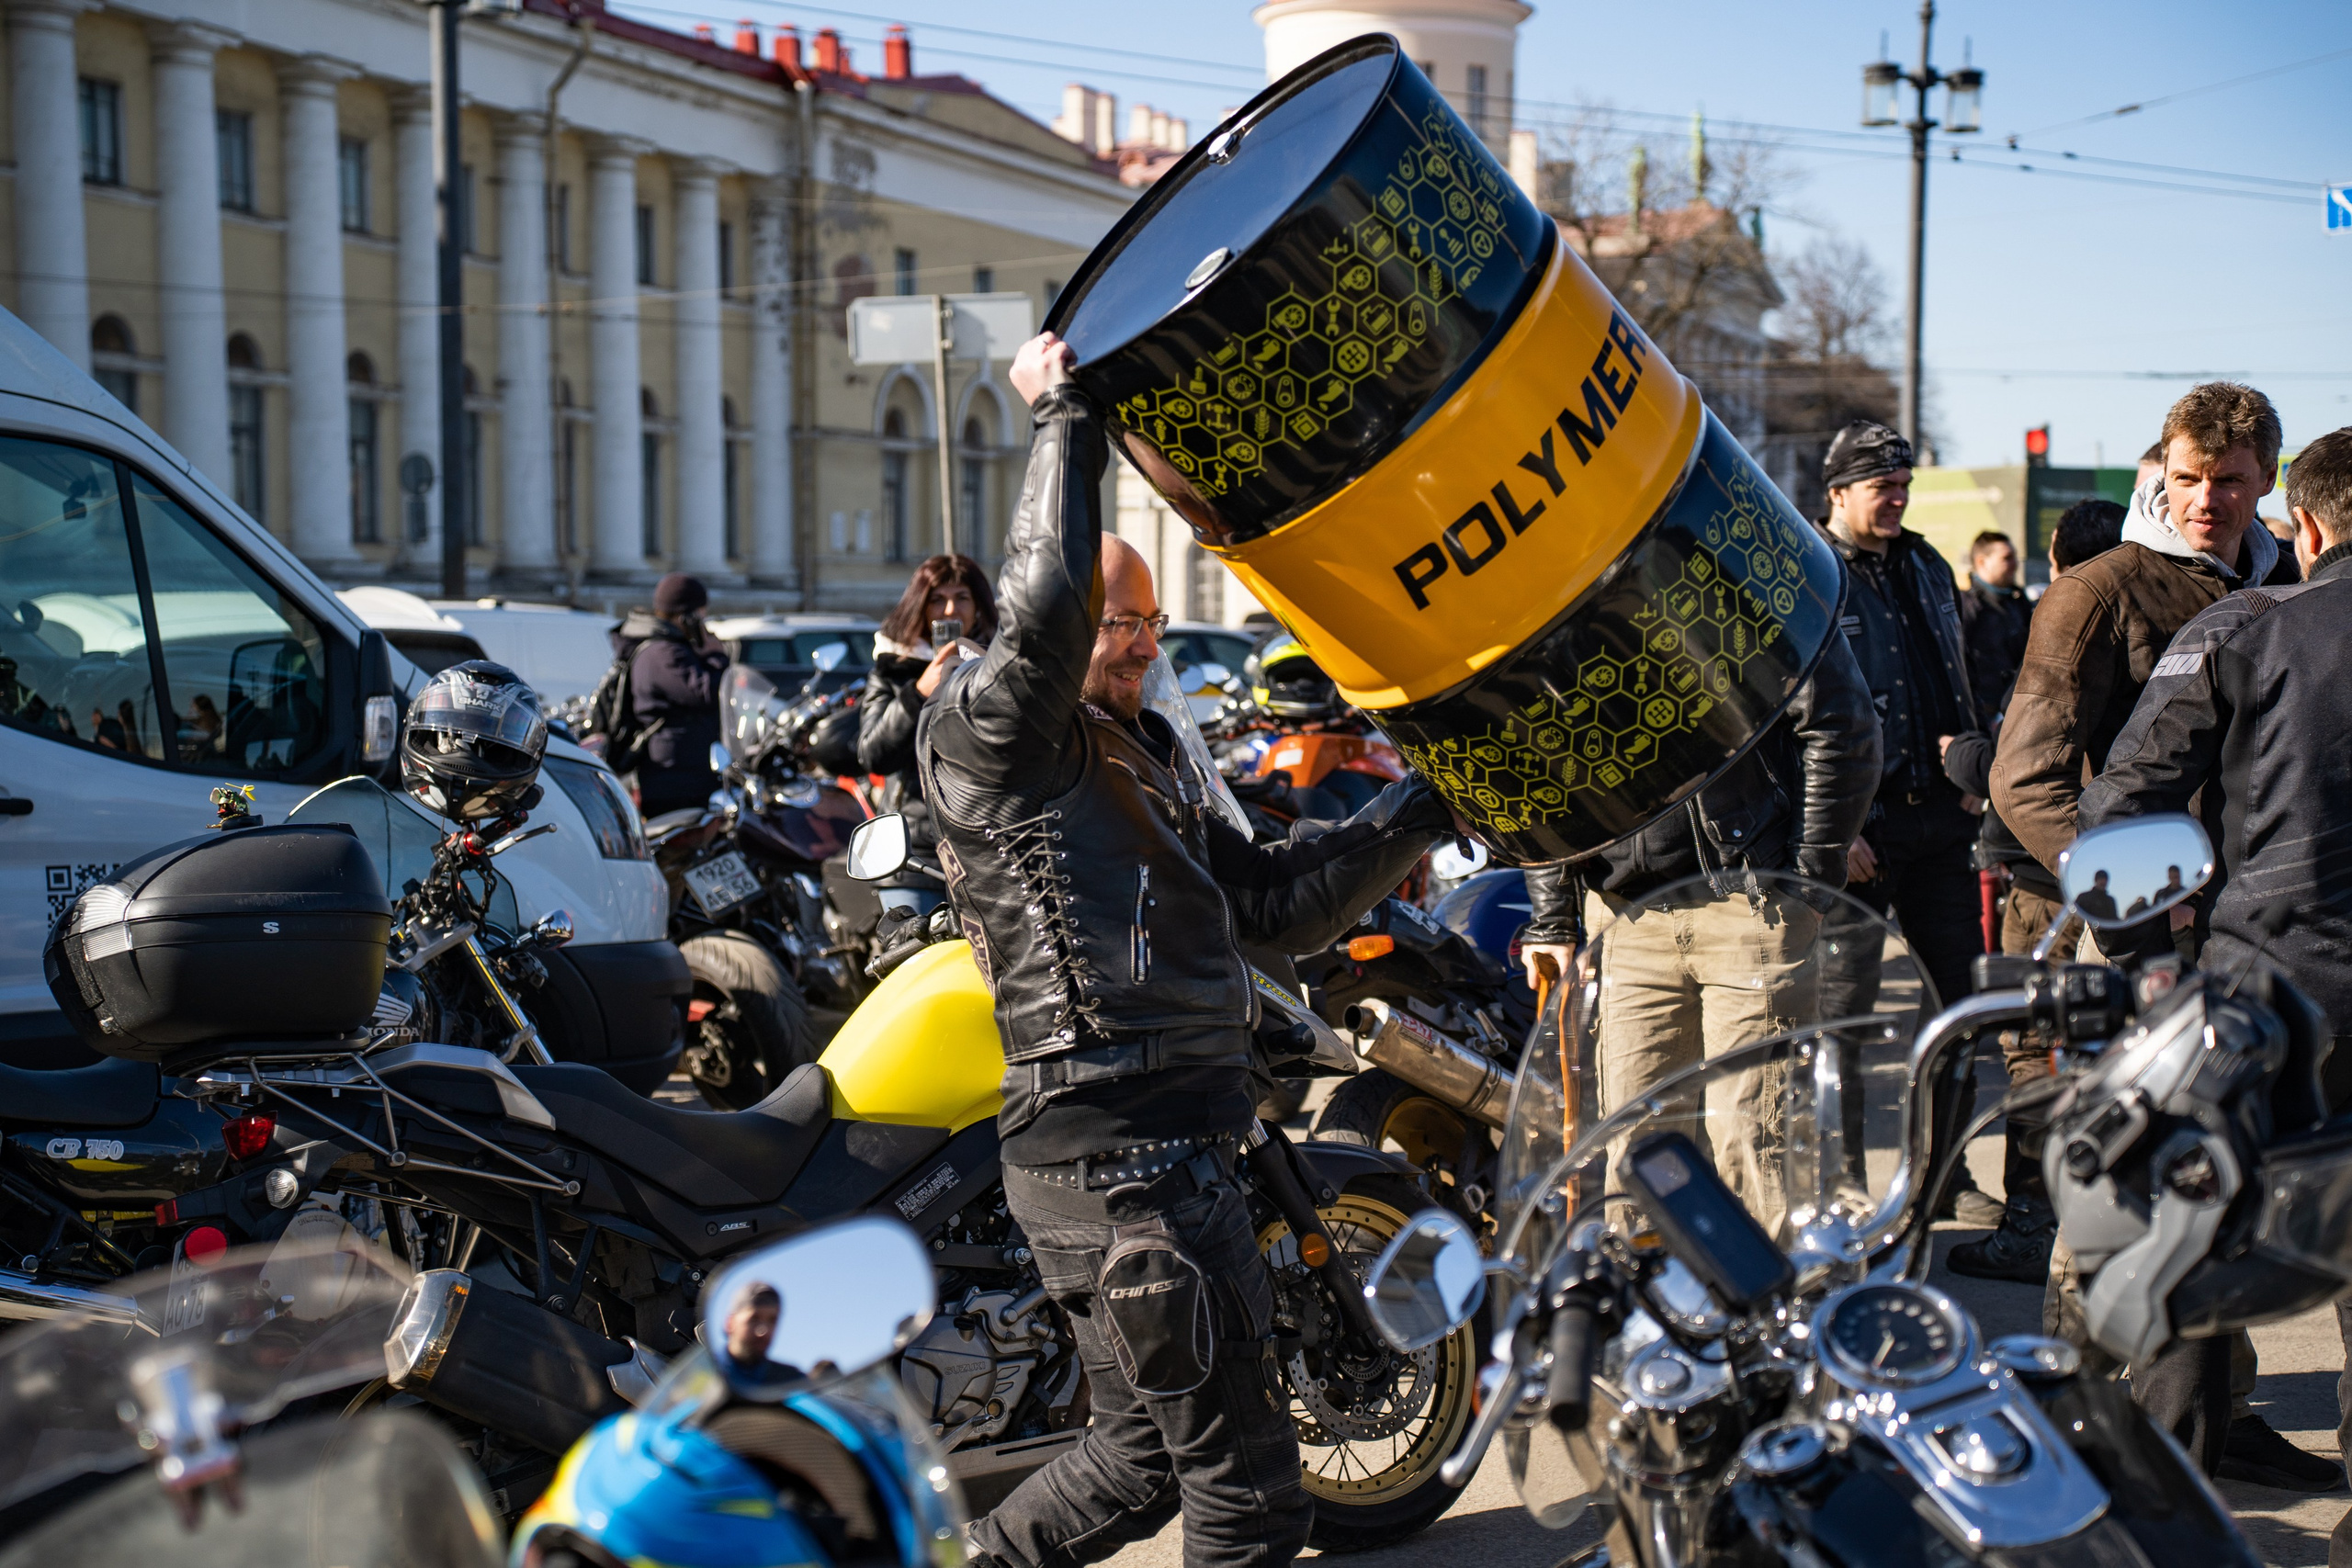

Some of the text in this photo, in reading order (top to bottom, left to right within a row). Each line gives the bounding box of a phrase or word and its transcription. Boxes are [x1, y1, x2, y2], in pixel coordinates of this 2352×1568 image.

[1393, 310, 1647, 612] POLYMER
[458, 697, 503, 714] SHARK
[695, 857, 736, 884] 1920
[731, 875, 755, 896] 56
[263, 921, 280, 934] S
[46, 1138, 125, 1161] CB 750
[720, 1221, 751, 1232] ABS
[1109, 1274, 1189, 1300] DAINESE
[187, 1286, 205, 1324] 78
[944, 1360, 987, 1376] SUZUKI
